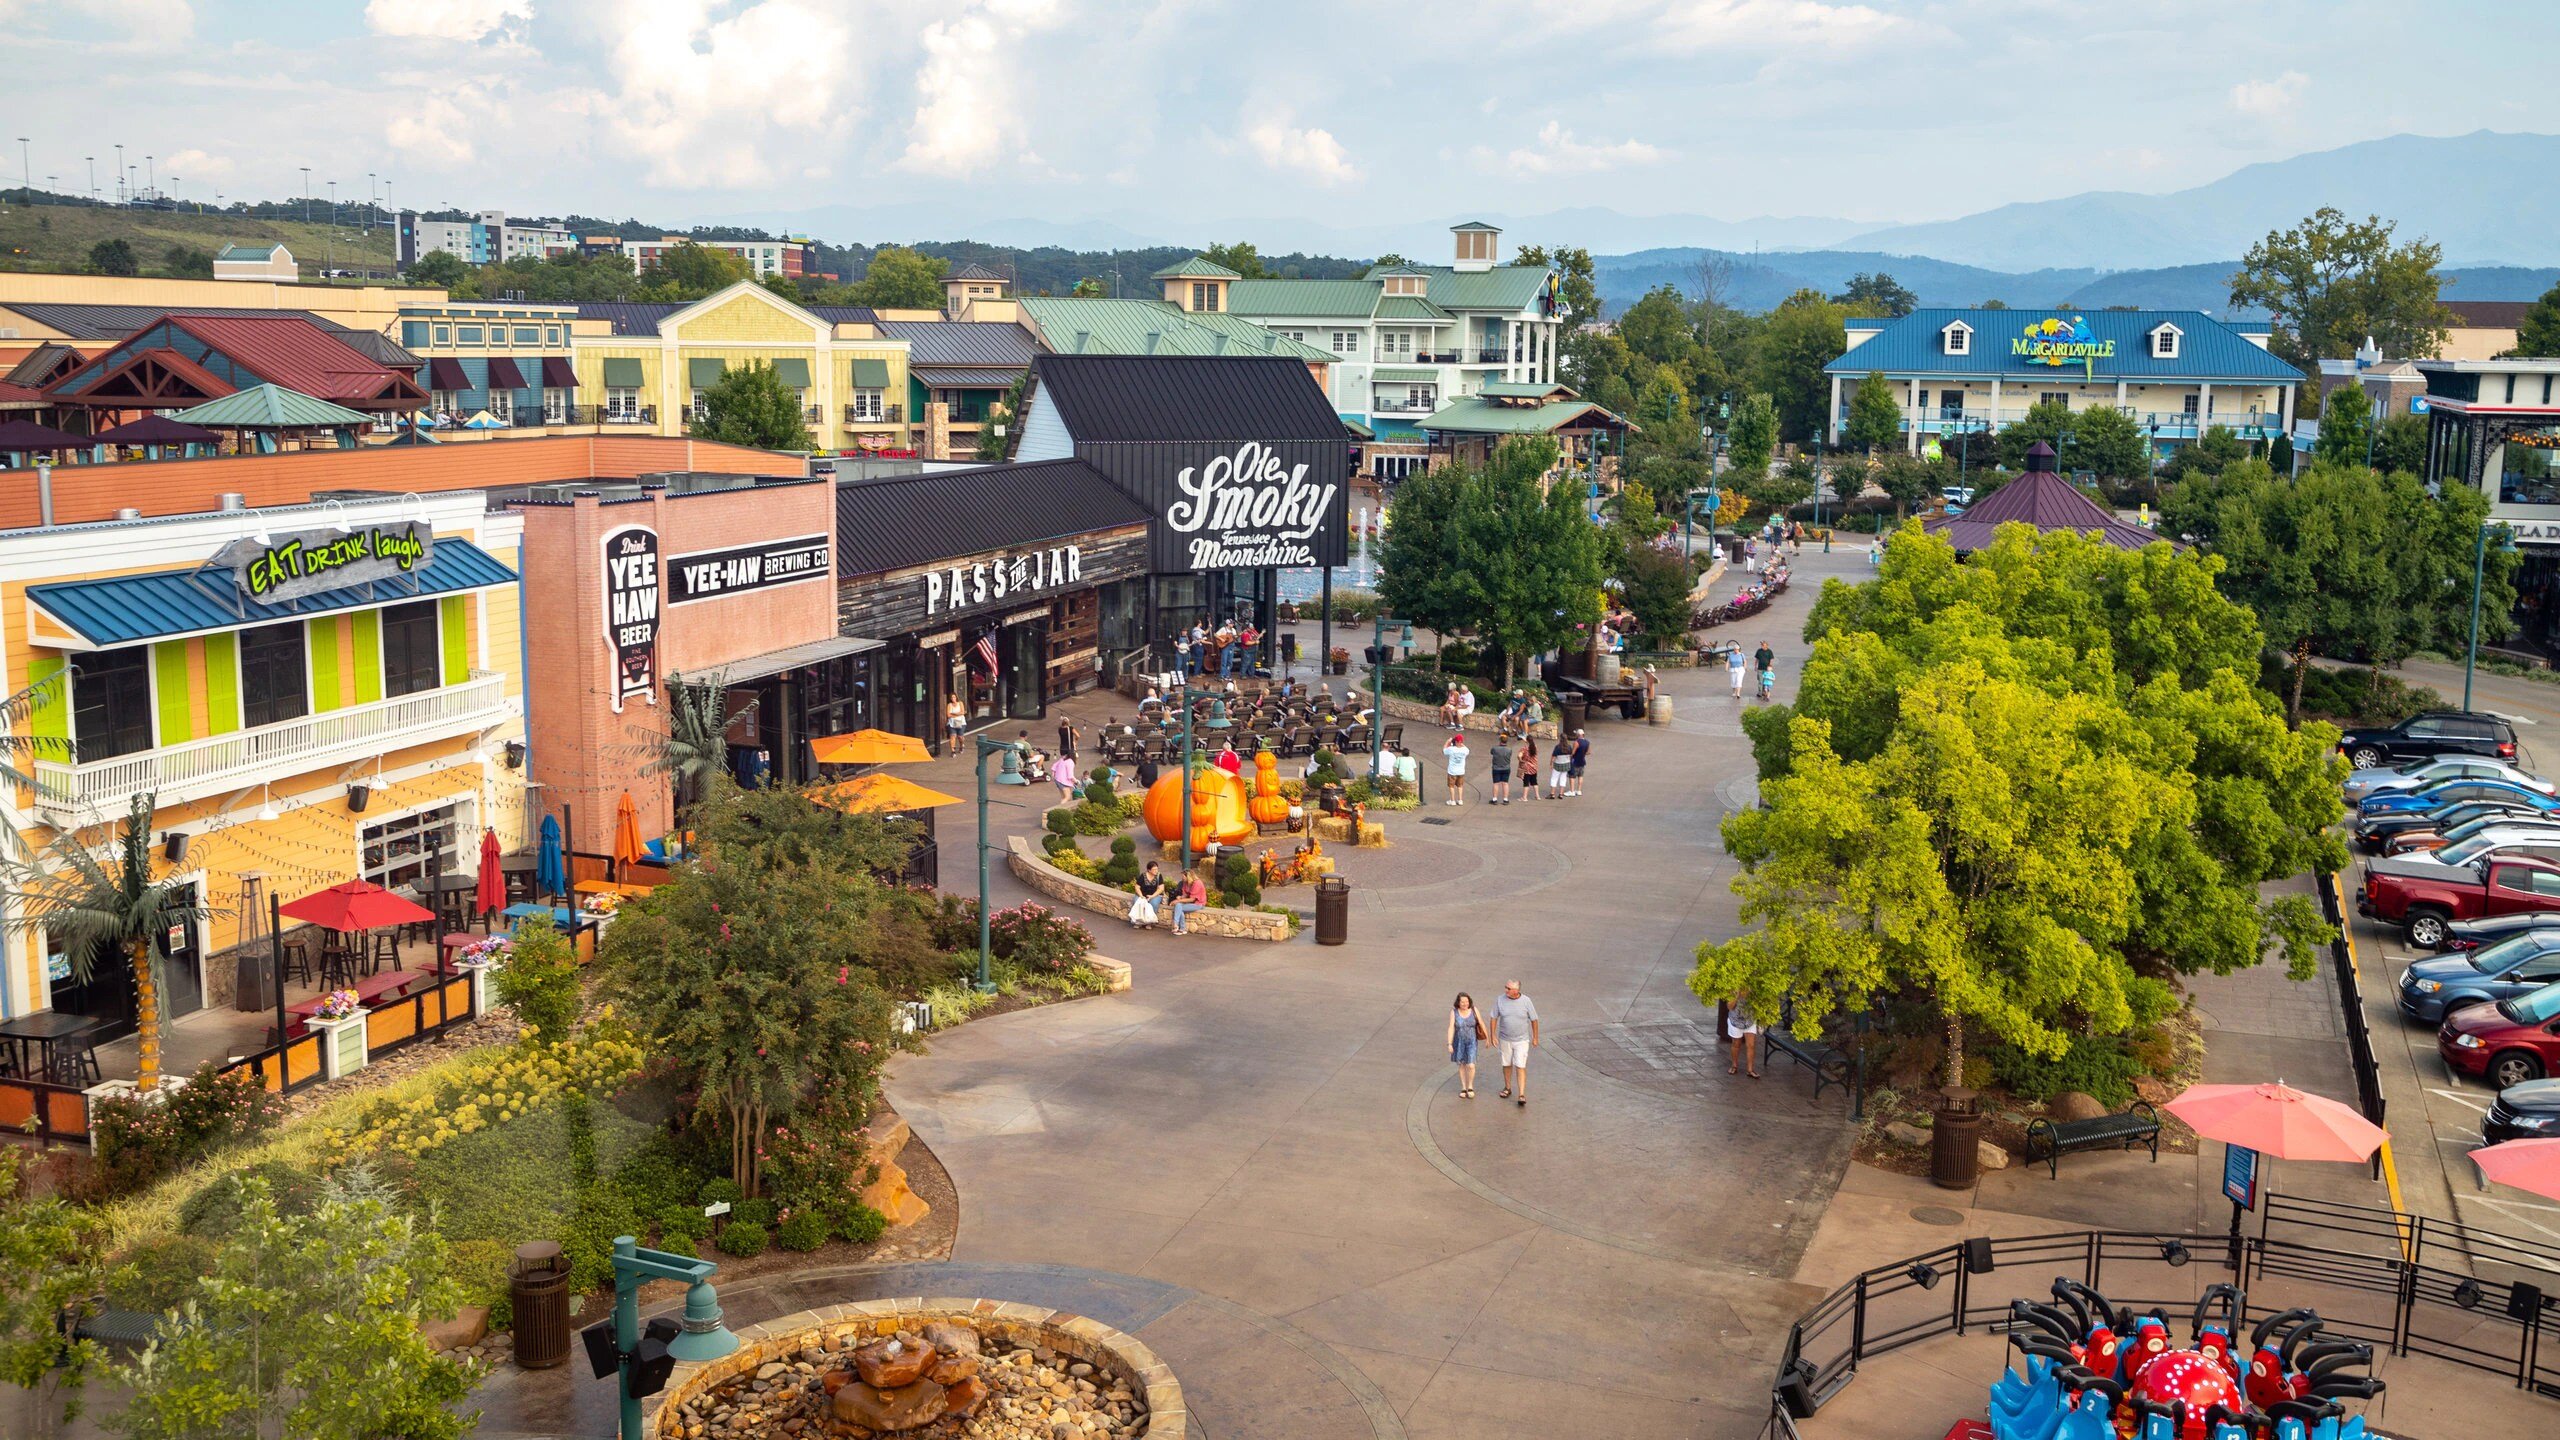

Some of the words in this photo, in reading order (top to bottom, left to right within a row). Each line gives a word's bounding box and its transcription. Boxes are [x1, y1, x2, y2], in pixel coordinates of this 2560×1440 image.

[2012, 338, 2115, 357] MARGARITAVILLE
[1233, 442, 1289, 484] Ole
[620, 534, 646, 554] Drink
[1189, 538, 1316, 569] Moonshine
[1221, 530, 1271, 546] Tennessee
[249, 540, 302, 595] EAT
[306, 534, 368, 575] DRINK
[374, 528, 423, 569] laugh
[609, 553, 657, 590] YEE
[683, 556, 762, 594] YEE-HAW
[765, 553, 811, 575] BREWING
[814, 549, 831, 567] CO.
[923, 559, 1007, 615] PASS
[1010, 561, 1027, 587] THE
[1031, 545, 1081, 591] JAR
[612, 587, 658, 625] HAW
[620, 624, 652, 647] BEER
[2086, 1399, 2095, 1411] 2
[2152, 1422, 2158, 1435] 1
